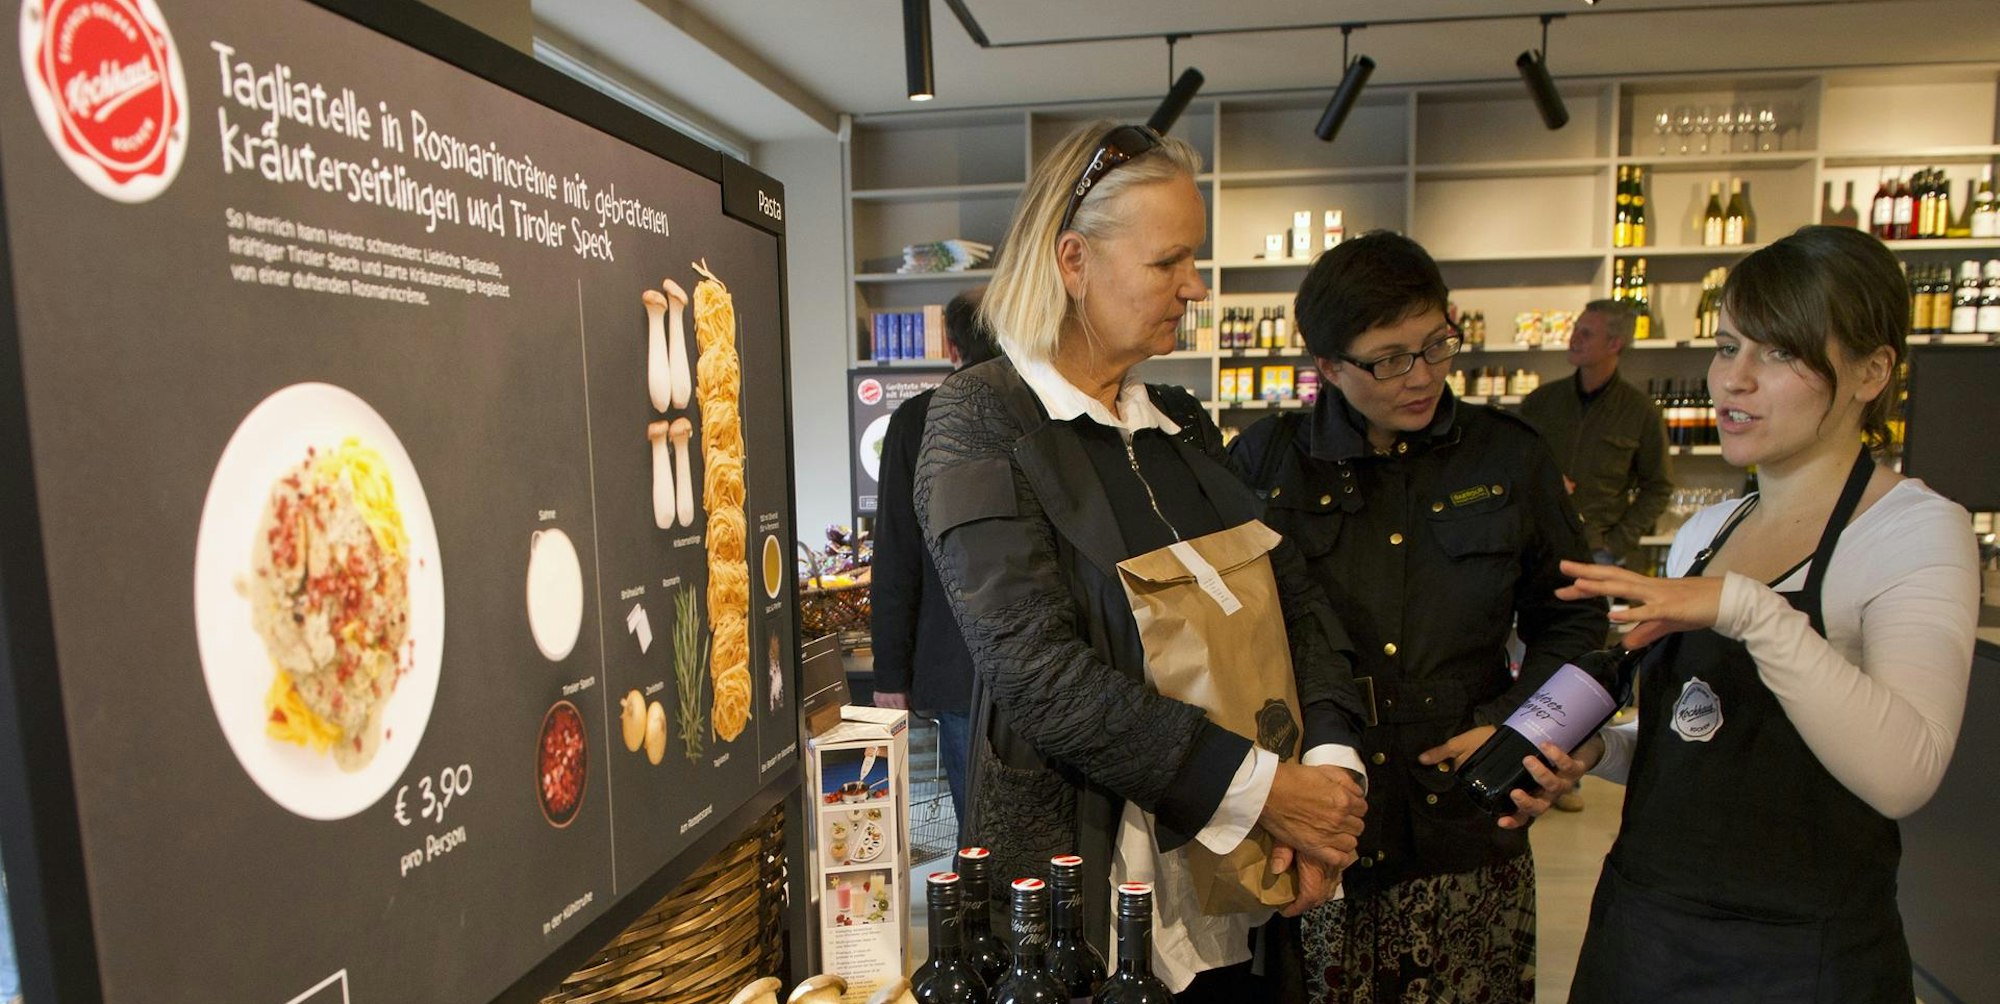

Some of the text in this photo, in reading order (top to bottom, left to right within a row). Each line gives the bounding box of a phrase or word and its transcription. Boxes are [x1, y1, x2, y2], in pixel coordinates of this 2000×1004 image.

[210, 40, 669, 237] Tagliatelle in Rosmarincrème mit gebratenen
[467, 194, 505, 237] und
[510, 199, 566, 248] Tiroler
[571, 217, 614, 262] Speck
[758, 189, 781, 221] Pasta
[225, 207, 245, 230] So
[246, 211, 296, 239] herrlich
[328, 228, 365, 251] Herbst
[230, 263, 257, 282] von
[258, 266, 291, 287] einer
[292, 271, 351, 295] duftenden
[287, 244, 326, 268] Tiroler
[327, 251, 360, 273] Speck
[361, 259, 382, 277] und
[382, 263, 408, 281] zarte
[394, 764, 473, 826] € 3,90
[401, 826, 466, 877] pro Person
